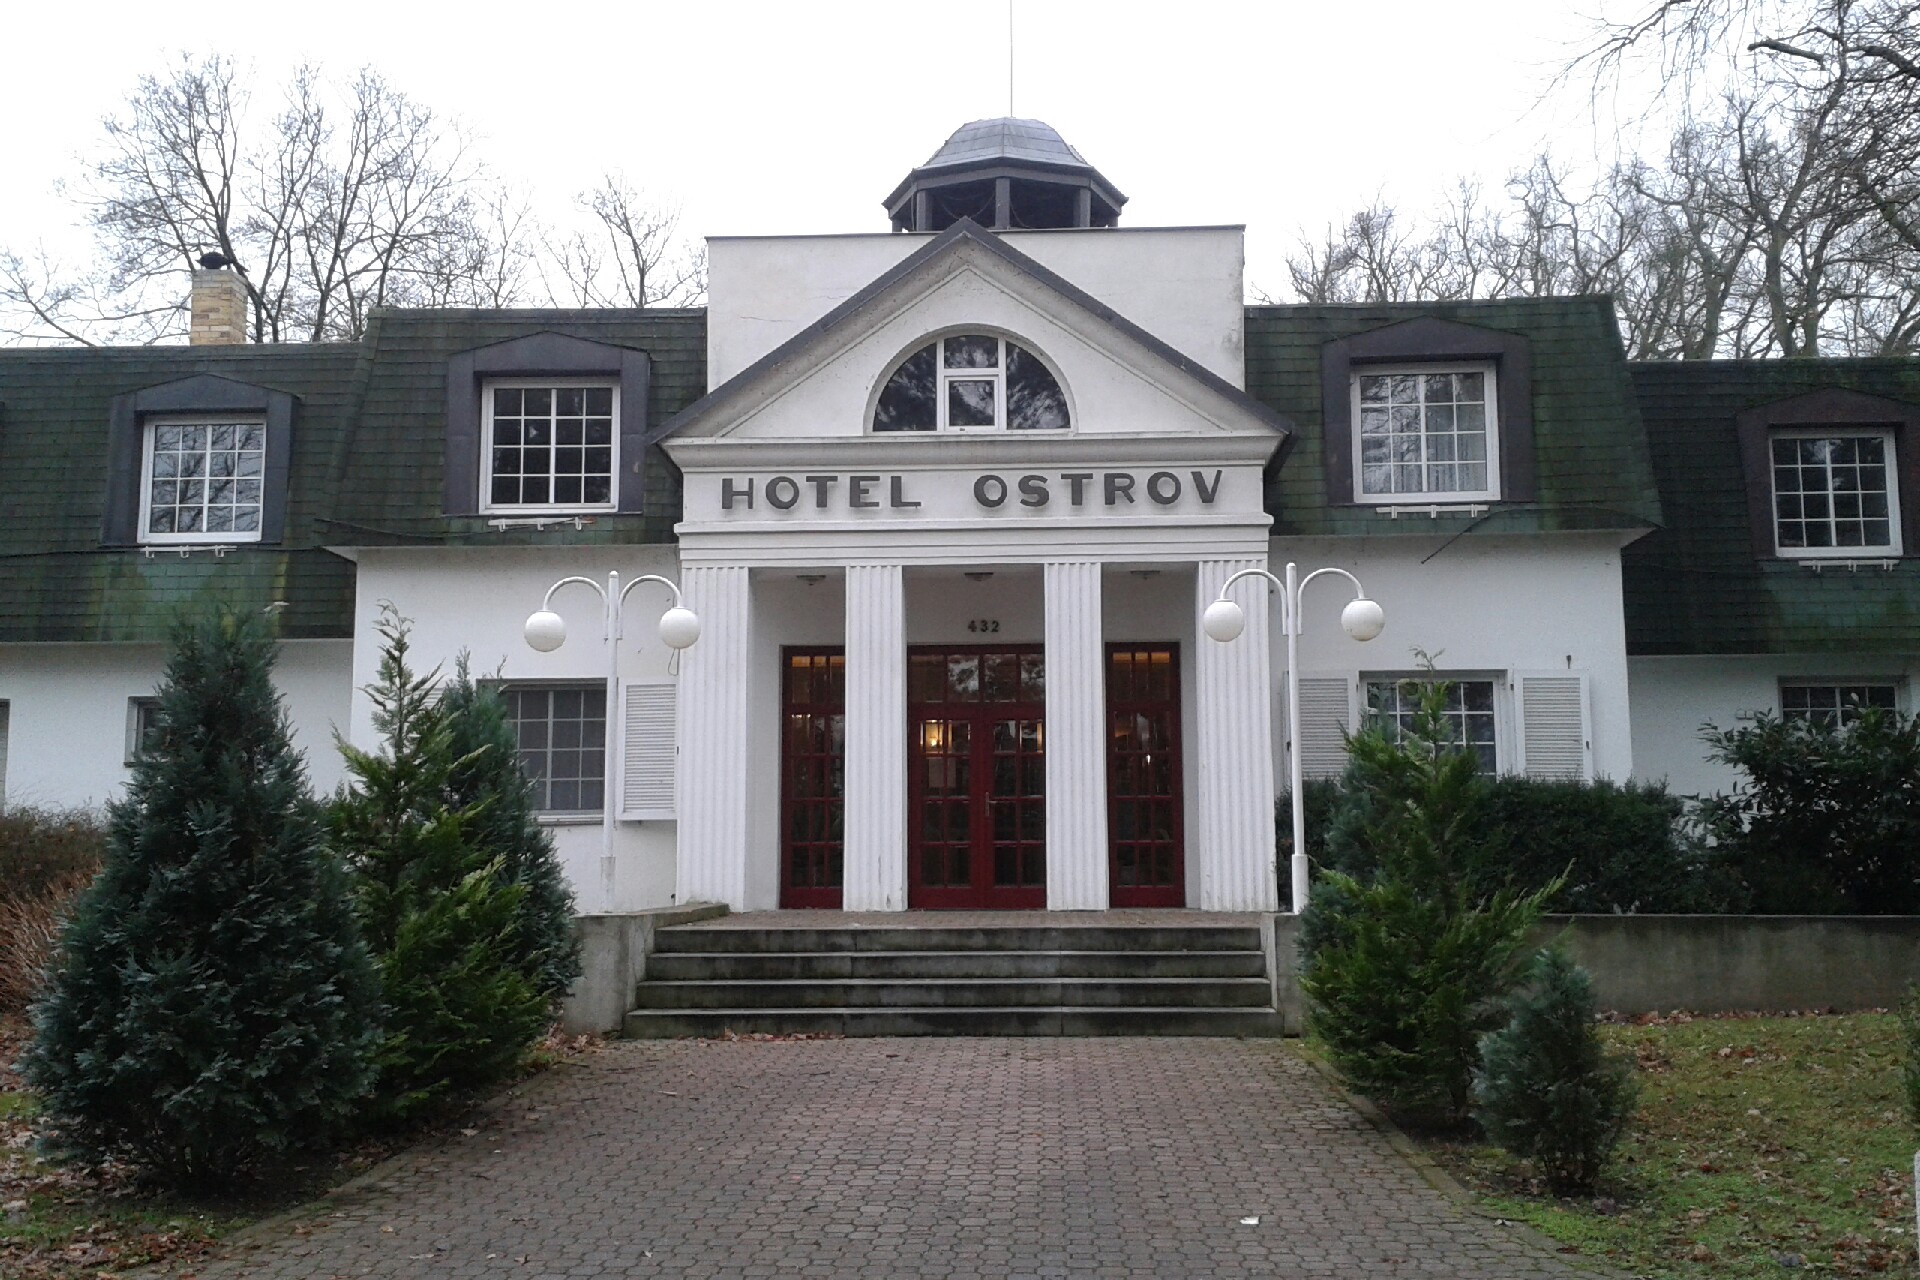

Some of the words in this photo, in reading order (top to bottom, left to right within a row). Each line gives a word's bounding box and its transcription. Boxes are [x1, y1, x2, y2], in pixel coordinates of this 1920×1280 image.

[721, 475, 922, 510] HOTEL
[973, 469, 1223, 508] OSTROV
[967, 619, 1000, 633] 432
